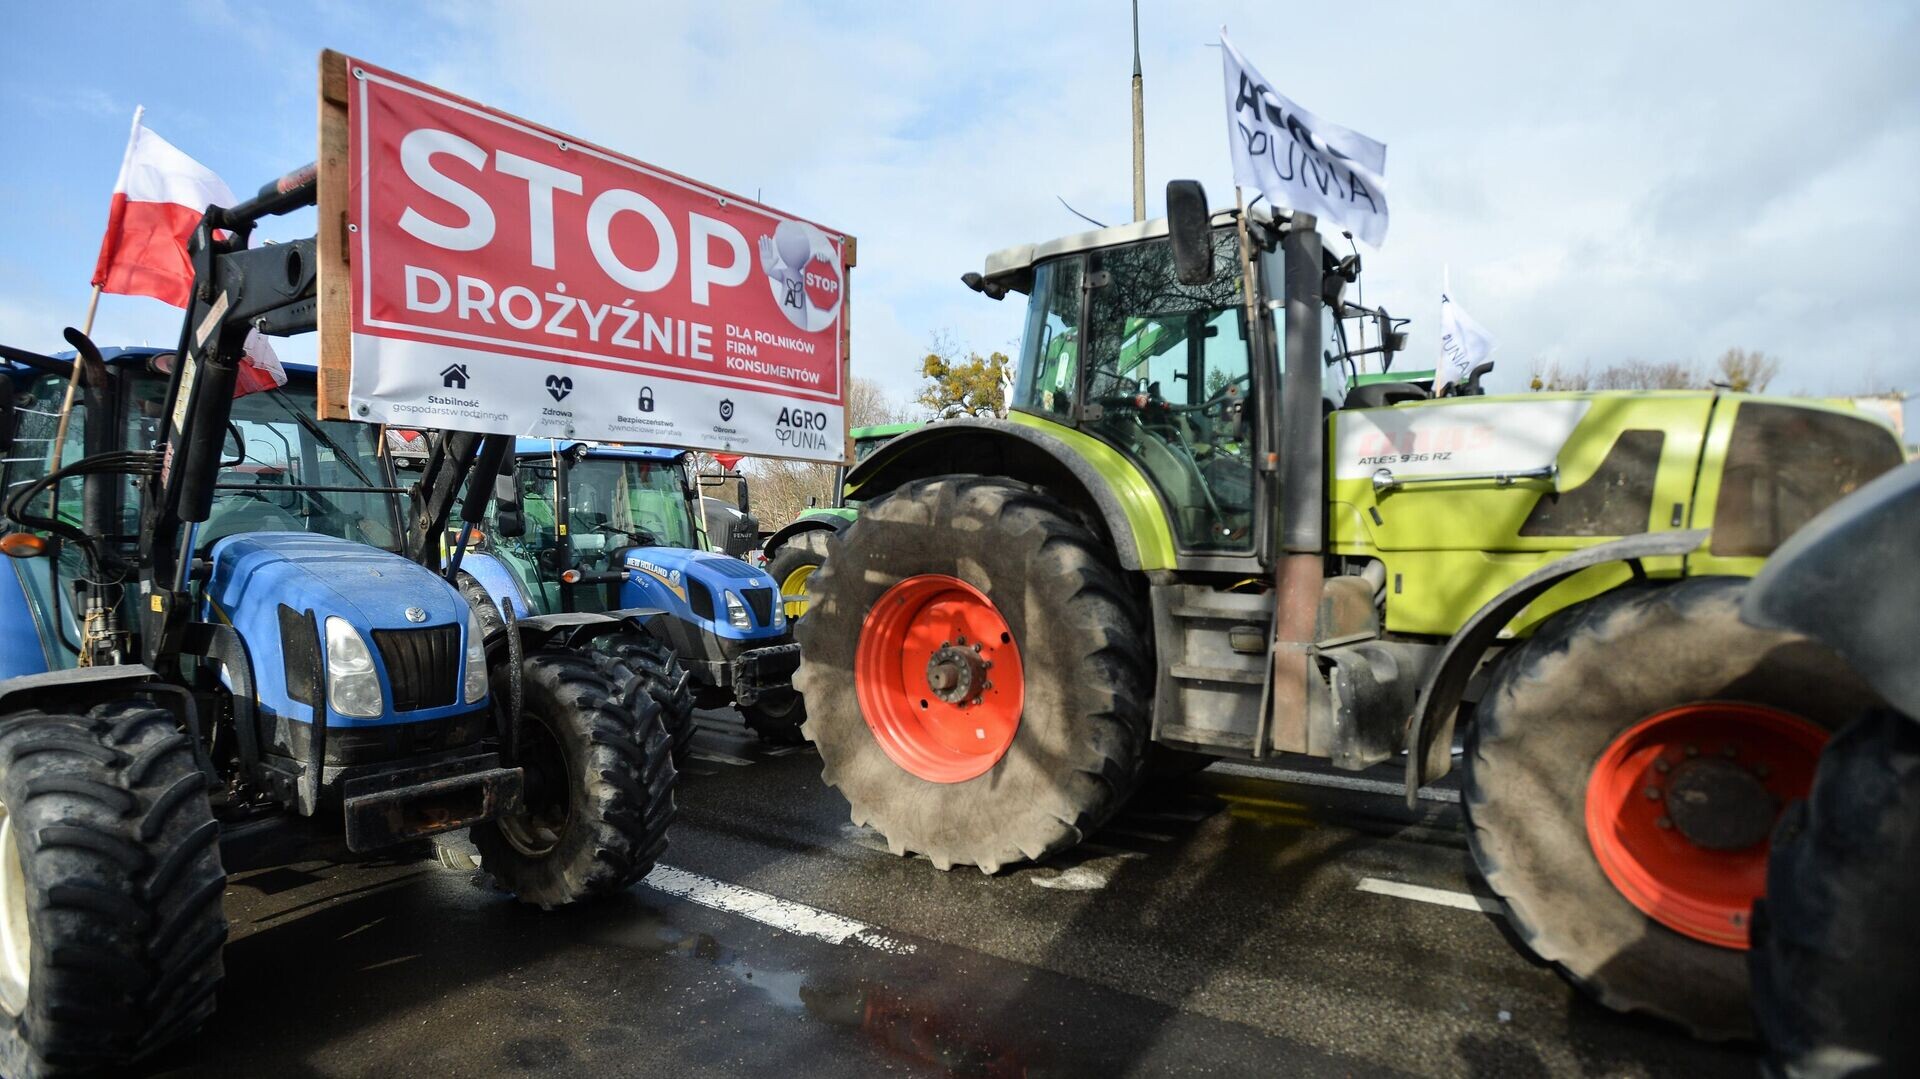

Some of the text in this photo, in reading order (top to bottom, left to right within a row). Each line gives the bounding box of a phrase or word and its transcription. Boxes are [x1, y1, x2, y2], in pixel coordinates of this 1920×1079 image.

[398, 128, 752, 307] STOP
[806, 272, 838, 294] STOP
[404, 264, 714, 362] DROŻYŹNIE
[725, 324, 815, 355] DLA ROLNIKÓW
[726, 340, 757, 357] FIRM
[726, 357, 820, 384] KONSUMENTÓW
[392, 403, 510, 421] gospodarstw rodzinnych
[428, 395, 480, 408] Stabilność
[542, 407, 573, 418] Zdrowa
[617, 415, 674, 427] Bezpieczeństwo
[776, 406, 827, 431] AGRO
[713, 425, 737, 434] Obrona
[791, 430, 828, 451] UNIA
[1358, 451, 1453, 466] ATLES 936 RZ
[626, 557, 668, 578] NEW HOLLAND
